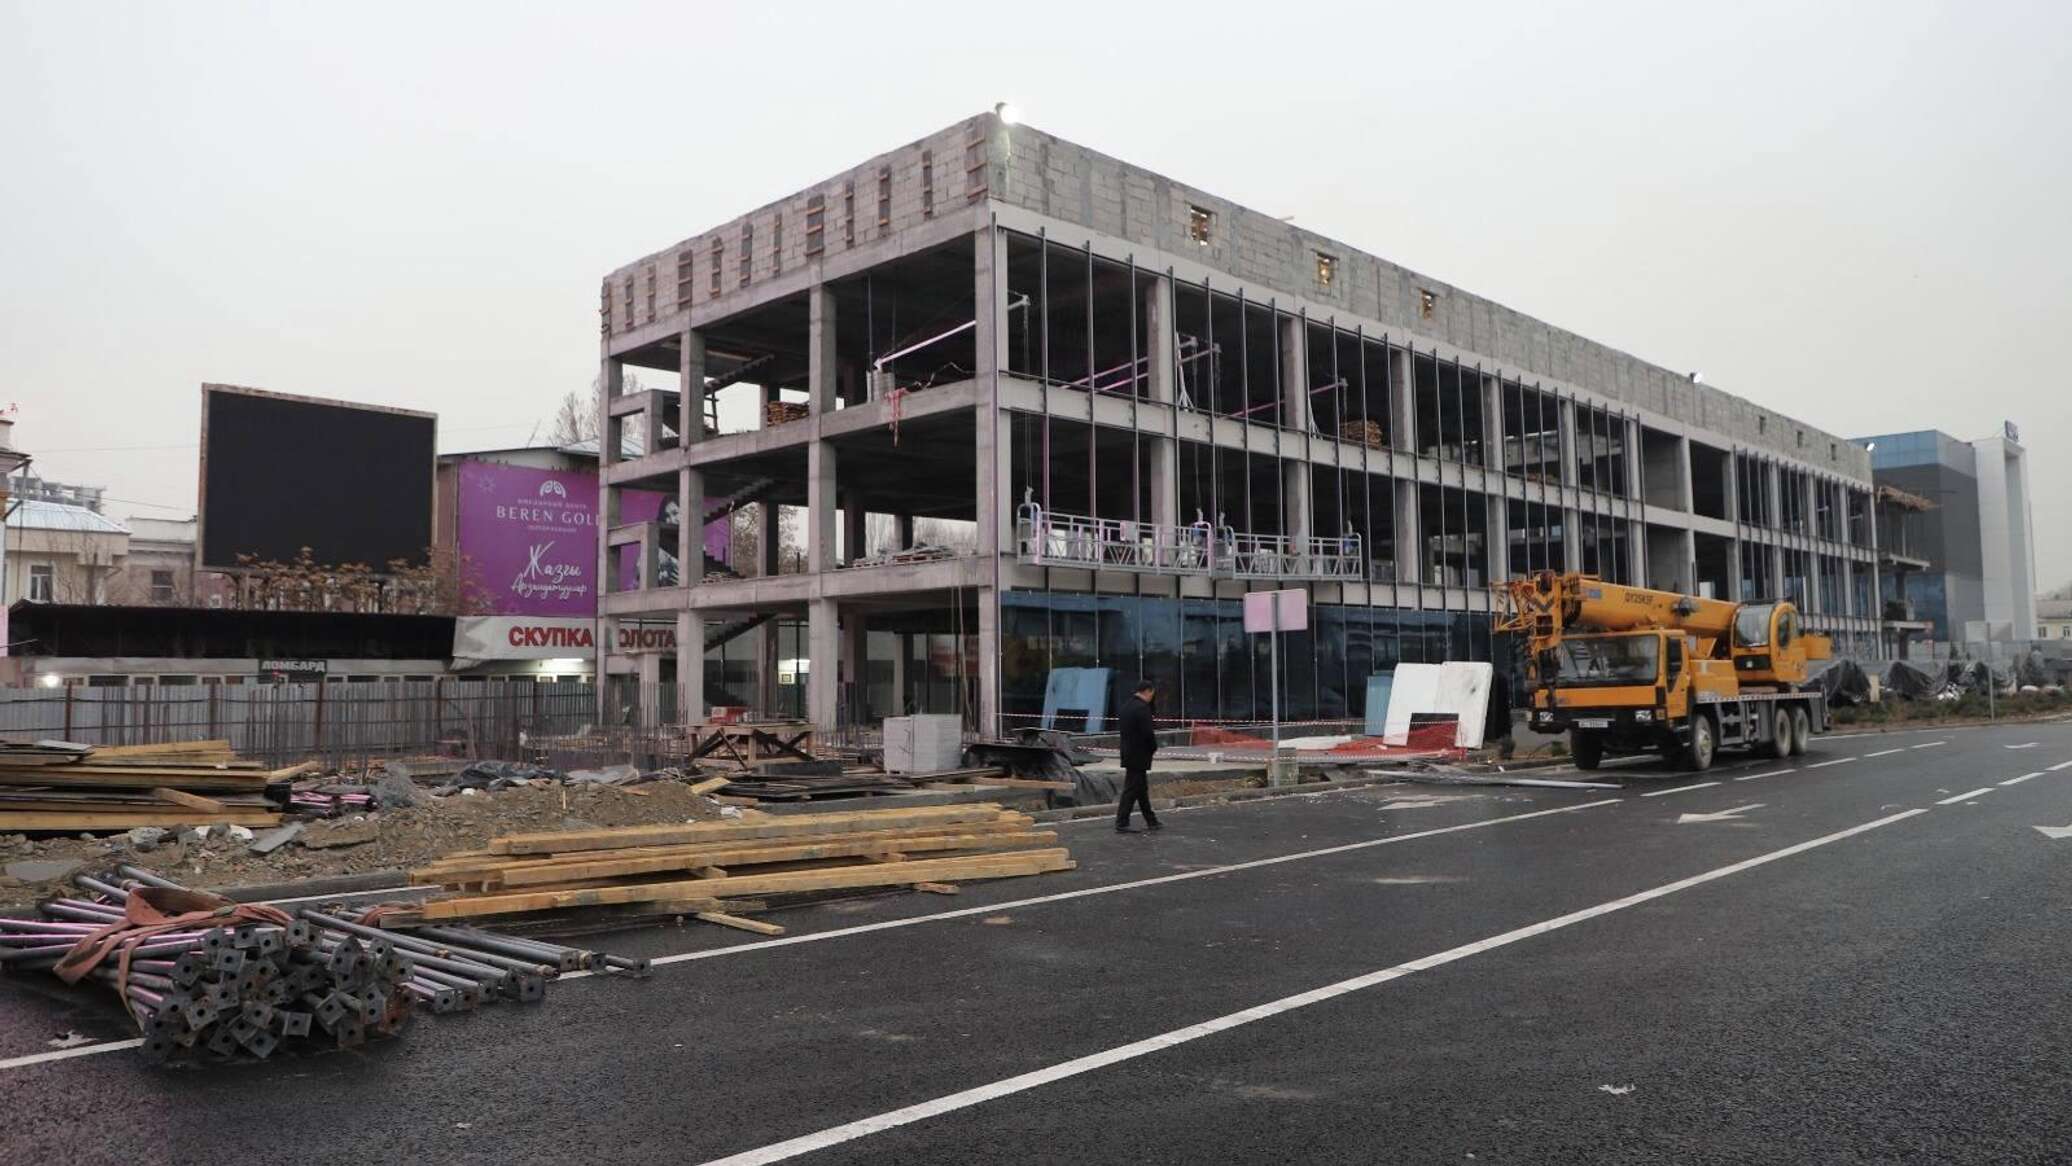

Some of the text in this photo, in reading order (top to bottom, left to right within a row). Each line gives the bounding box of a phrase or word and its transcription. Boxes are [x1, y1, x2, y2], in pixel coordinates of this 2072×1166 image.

[496, 505, 553, 521] BEREN
[508, 625, 594, 648] СКУПКА
[261, 660, 326, 673] ЛОМБАРД
